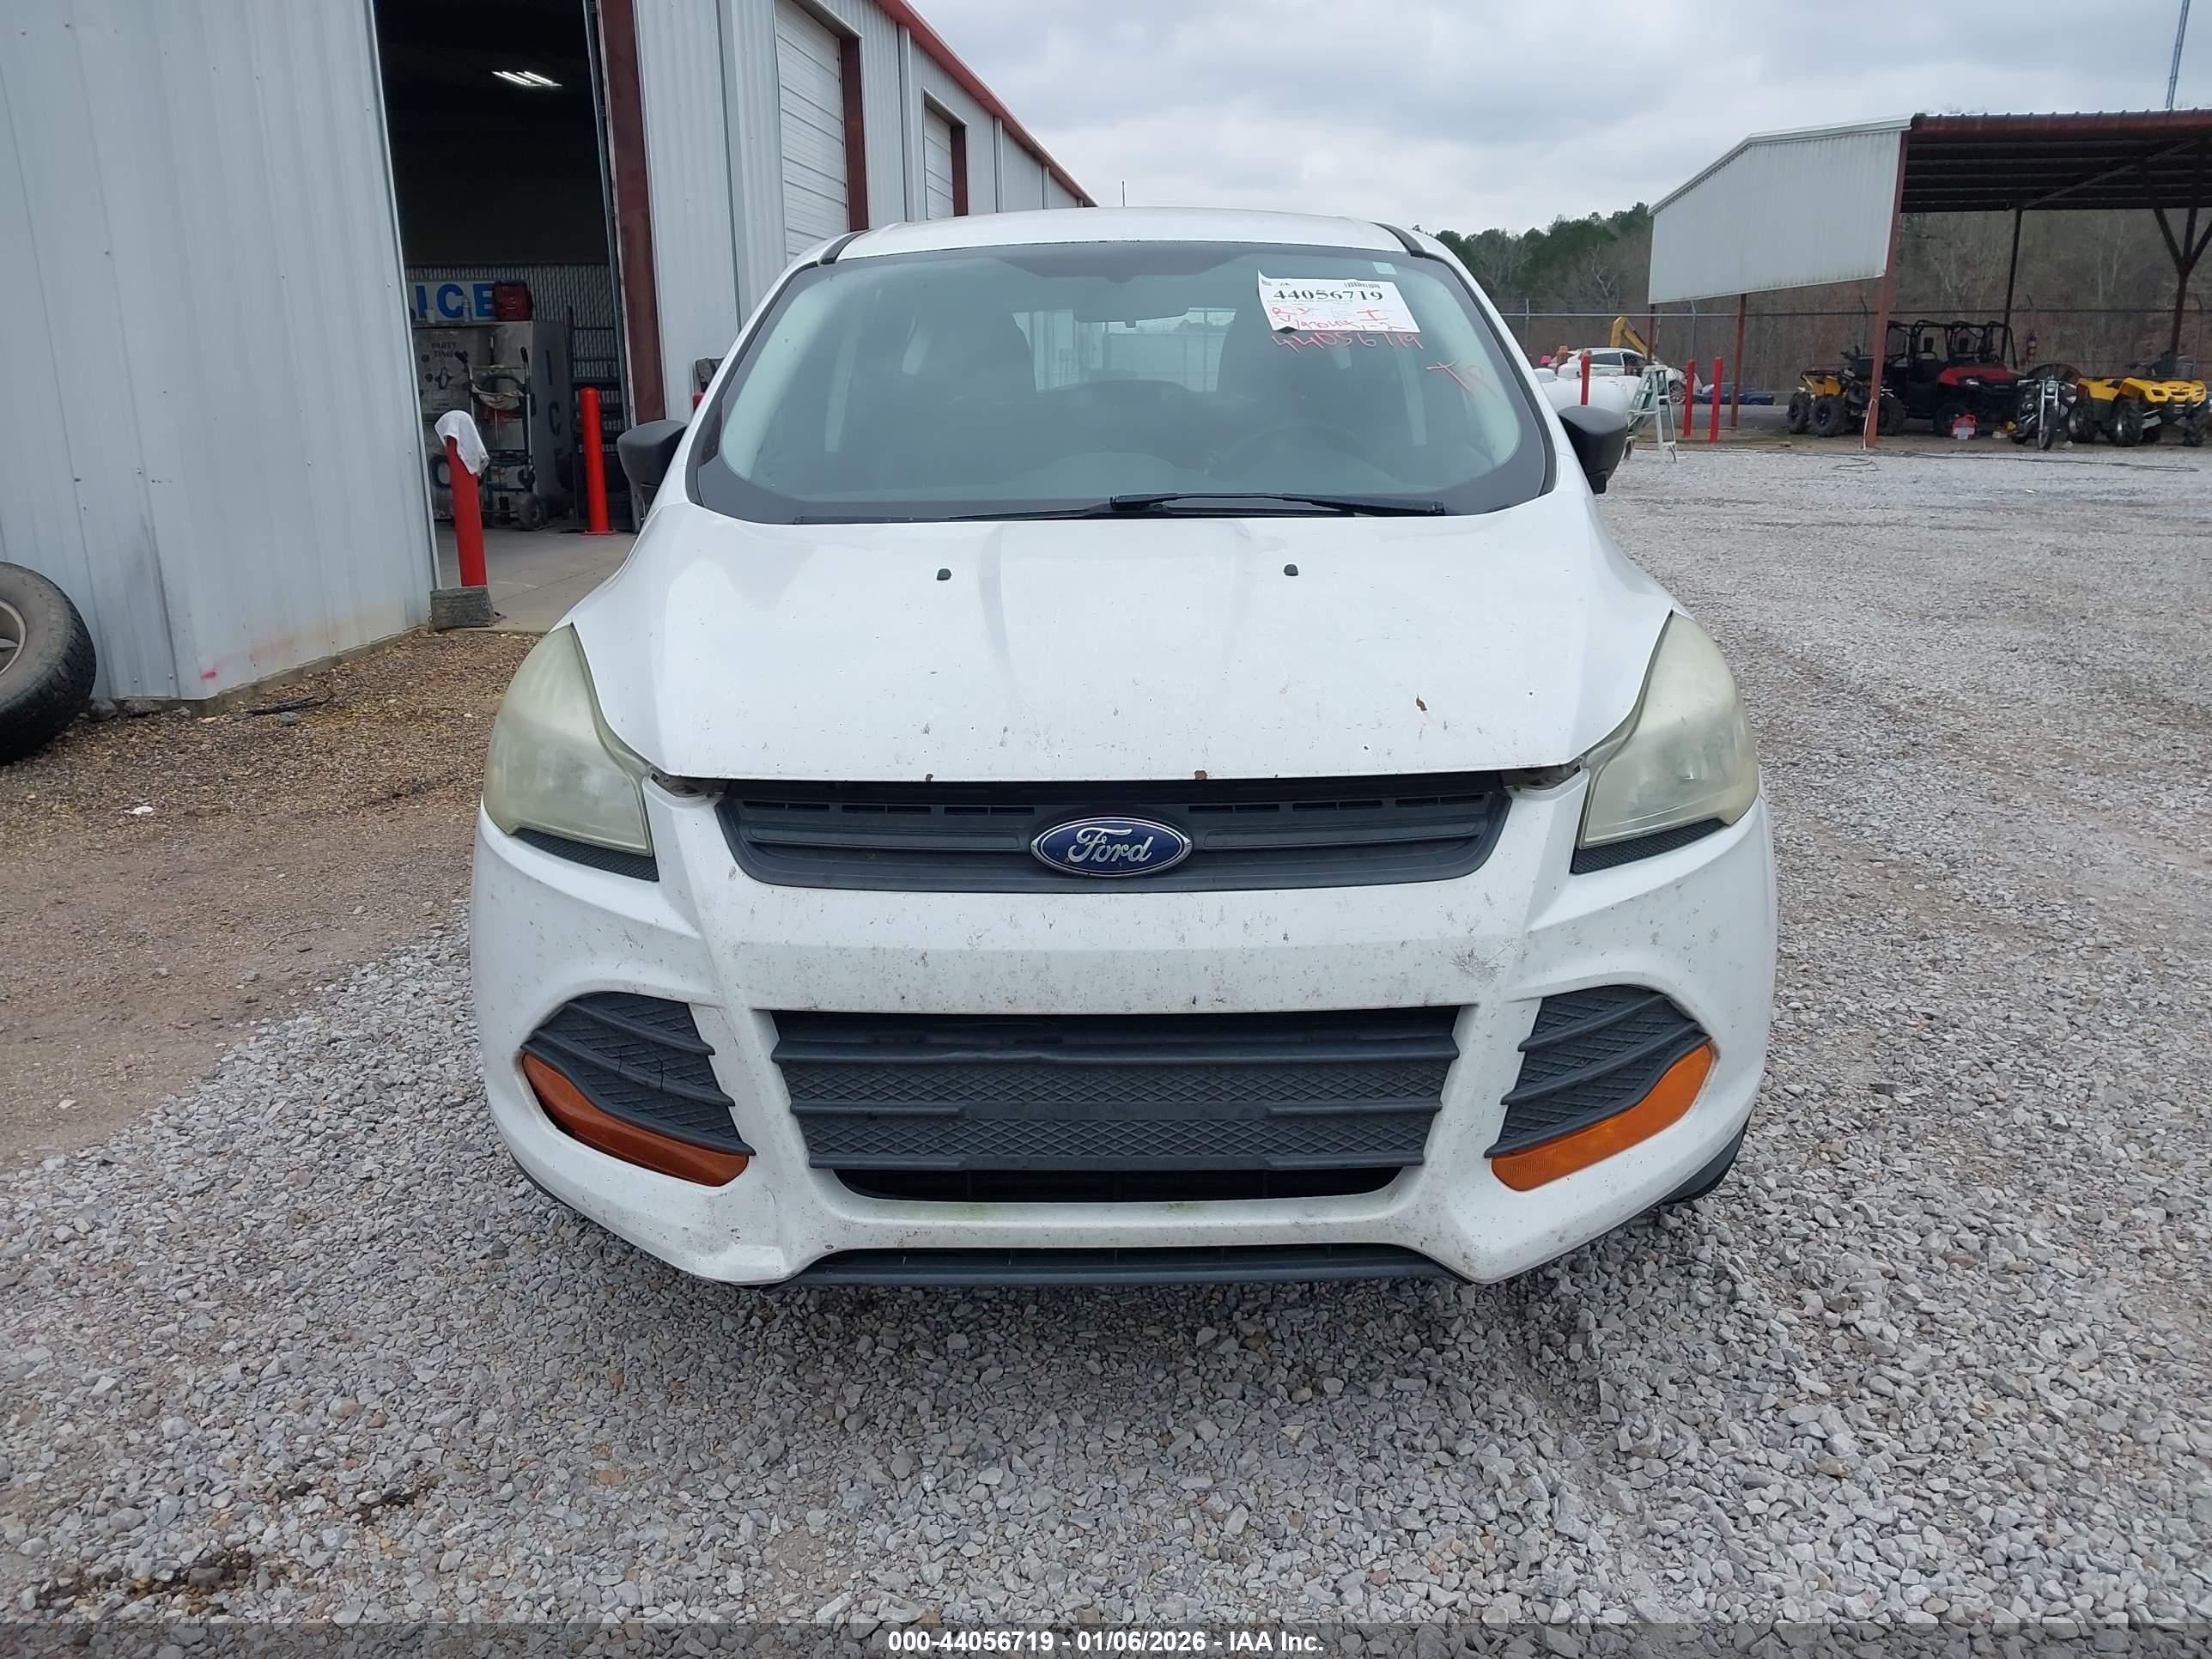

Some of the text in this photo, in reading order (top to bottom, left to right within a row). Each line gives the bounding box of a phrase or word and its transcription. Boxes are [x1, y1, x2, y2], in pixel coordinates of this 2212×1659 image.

[416, 283, 495, 319] ICE
[1273, 289, 1383, 301] 44056719
[431, 342, 456, 350] PARTY
[1271, 331, 1424, 353] 44056719
[434, 349, 455, 358] TIME
[1067, 827, 1154, 863] Ford
